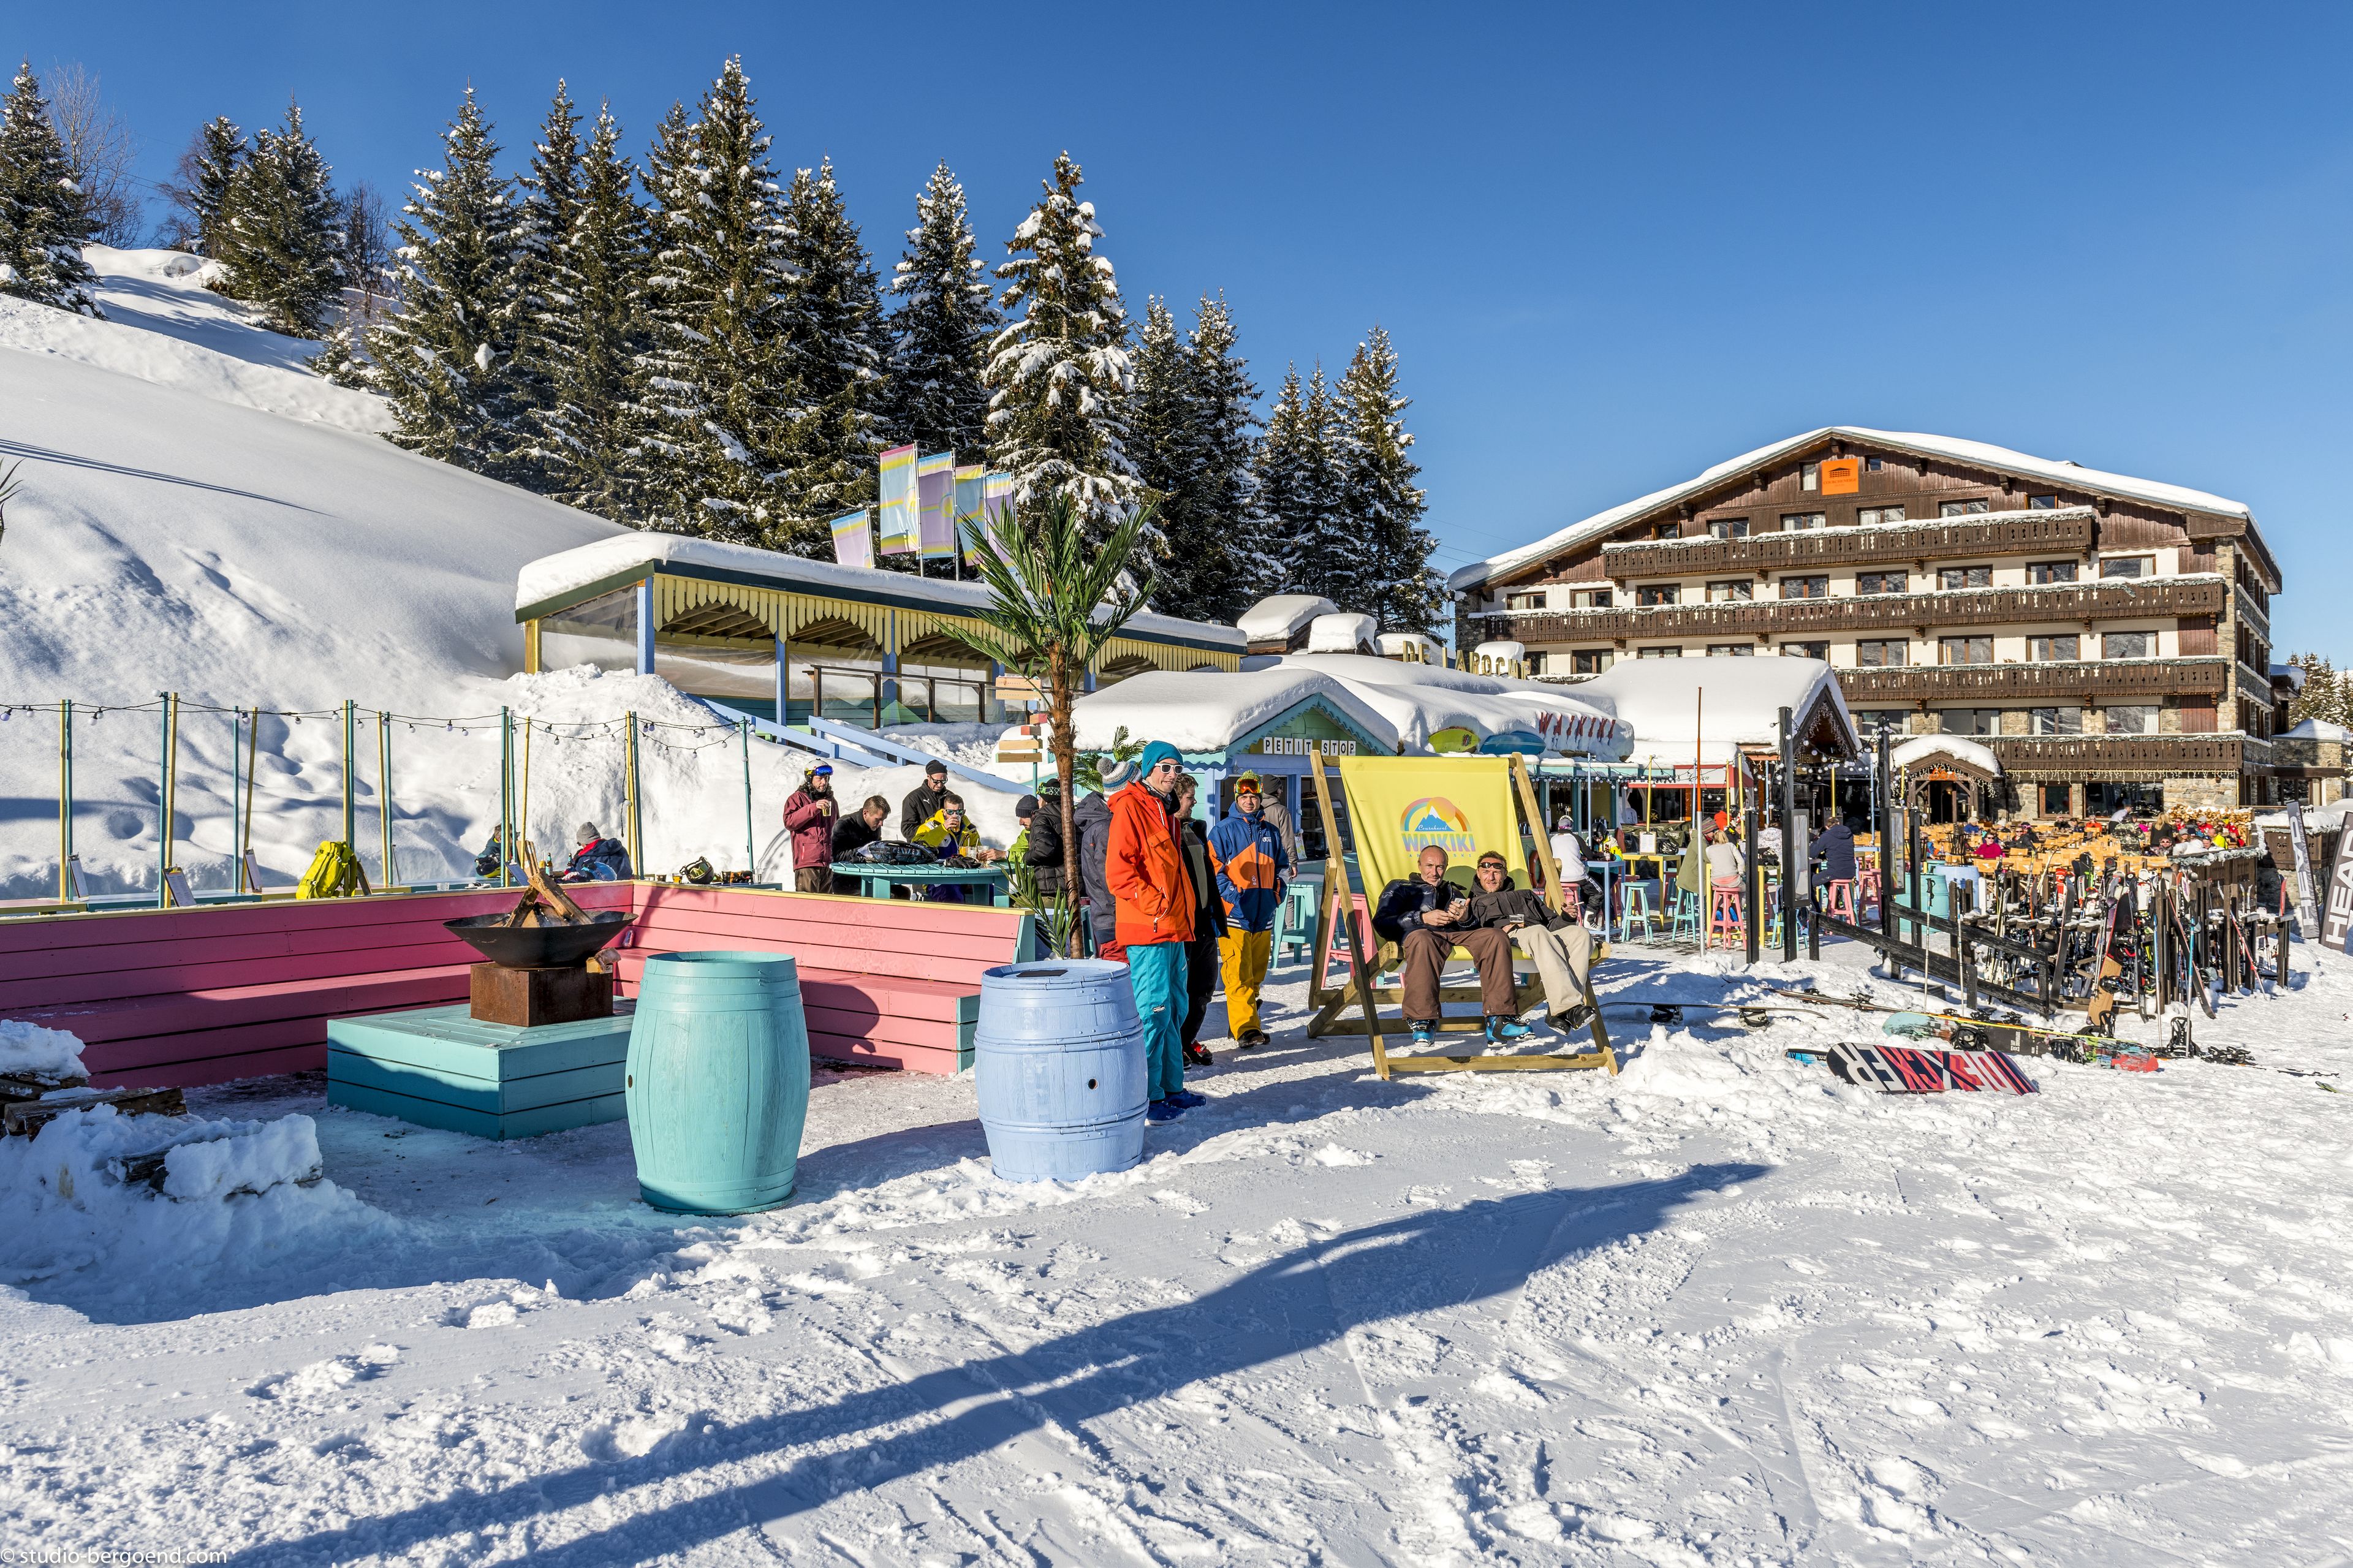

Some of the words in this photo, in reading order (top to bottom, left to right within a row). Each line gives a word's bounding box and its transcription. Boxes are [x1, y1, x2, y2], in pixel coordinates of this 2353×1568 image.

[1403, 640, 1430, 664] DE
[1469, 651, 1531, 681] ROCHE
[1539, 712, 1616, 739] WAIKIKI
[1265, 740, 1311, 753] PETIT
[1323, 743, 1354, 754] STOP
[1401, 833, 1476, 852] WAIKIKI
[2290, 816, 2314, 926] HEAD
